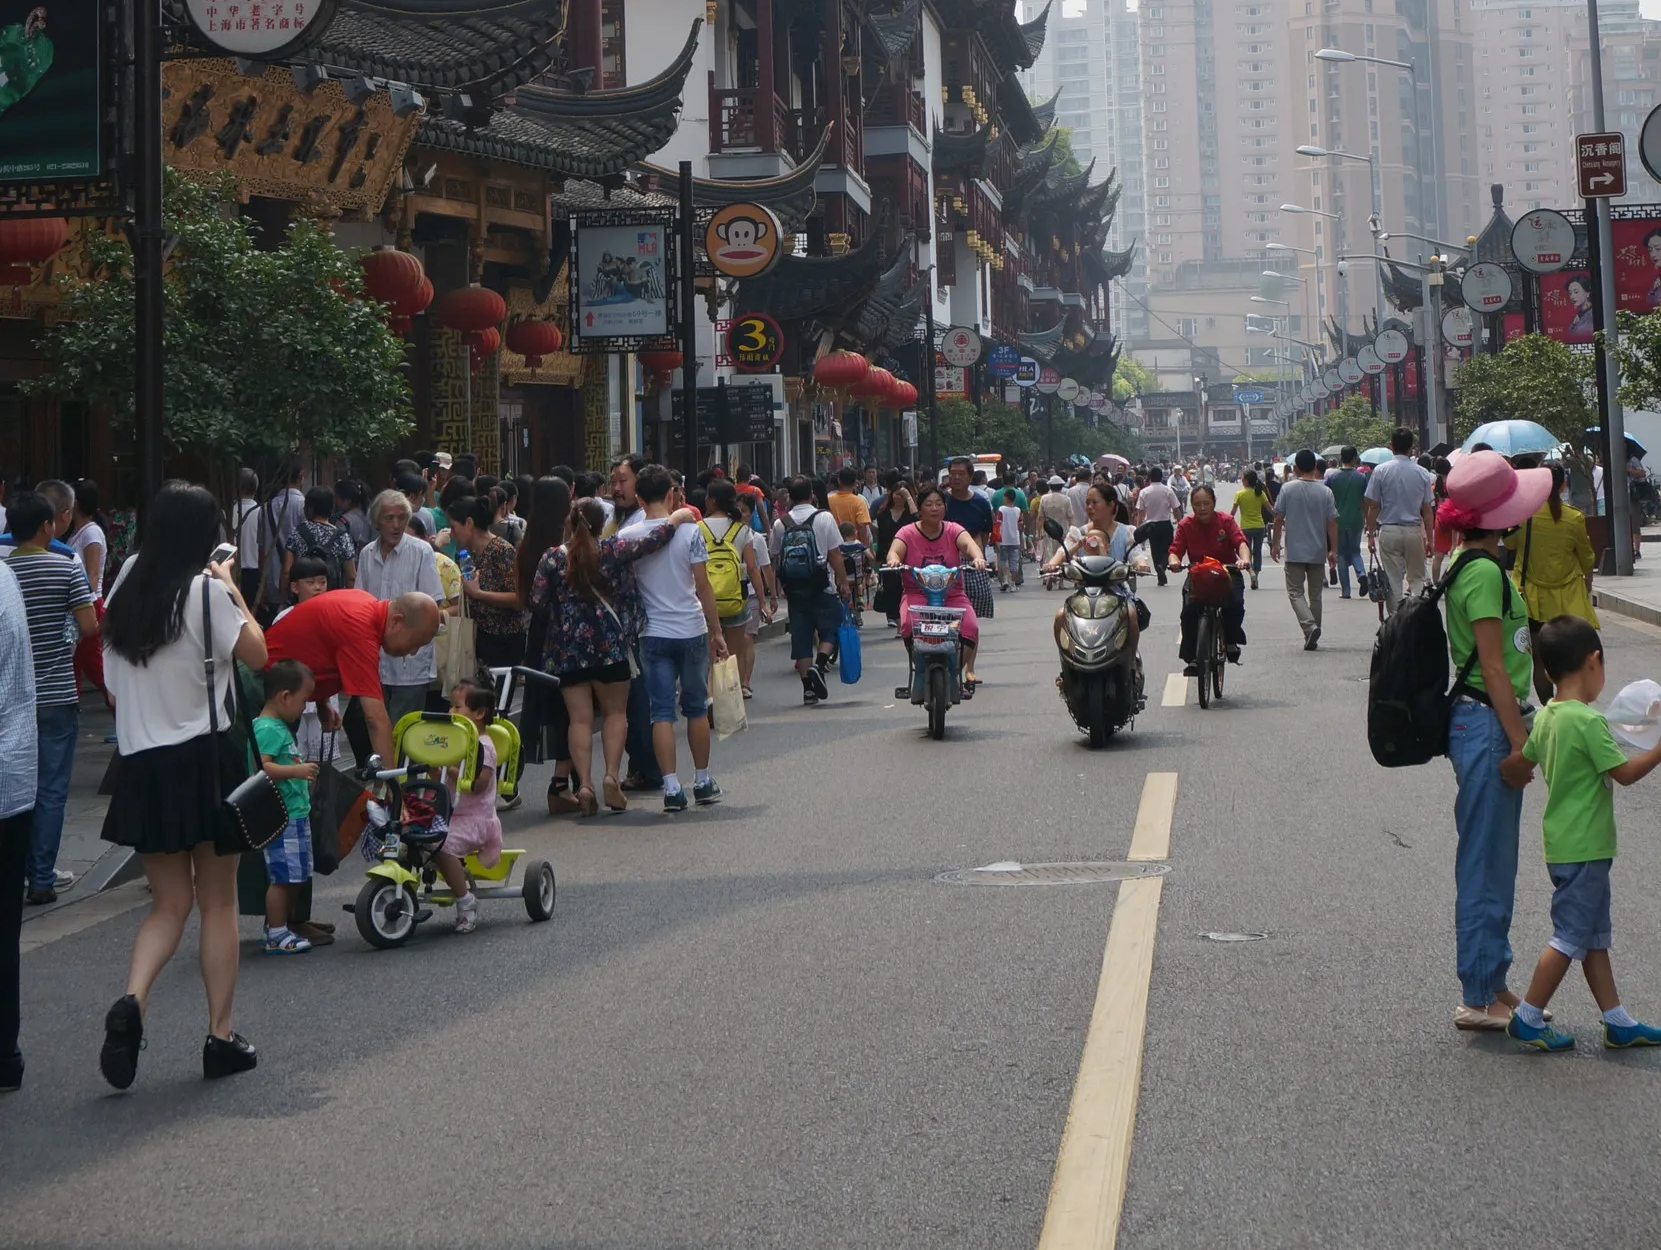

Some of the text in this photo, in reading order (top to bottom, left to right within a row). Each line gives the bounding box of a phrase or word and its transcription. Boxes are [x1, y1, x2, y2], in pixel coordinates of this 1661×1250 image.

[206, 4, 305, 18] 中华老字号
[208, 17, 305, 31] 上海市著名商标
[638, 243, 657, 255] MLB
[738, 319, 767, 352] 3
[998, 346, 1009, 354] 3F
